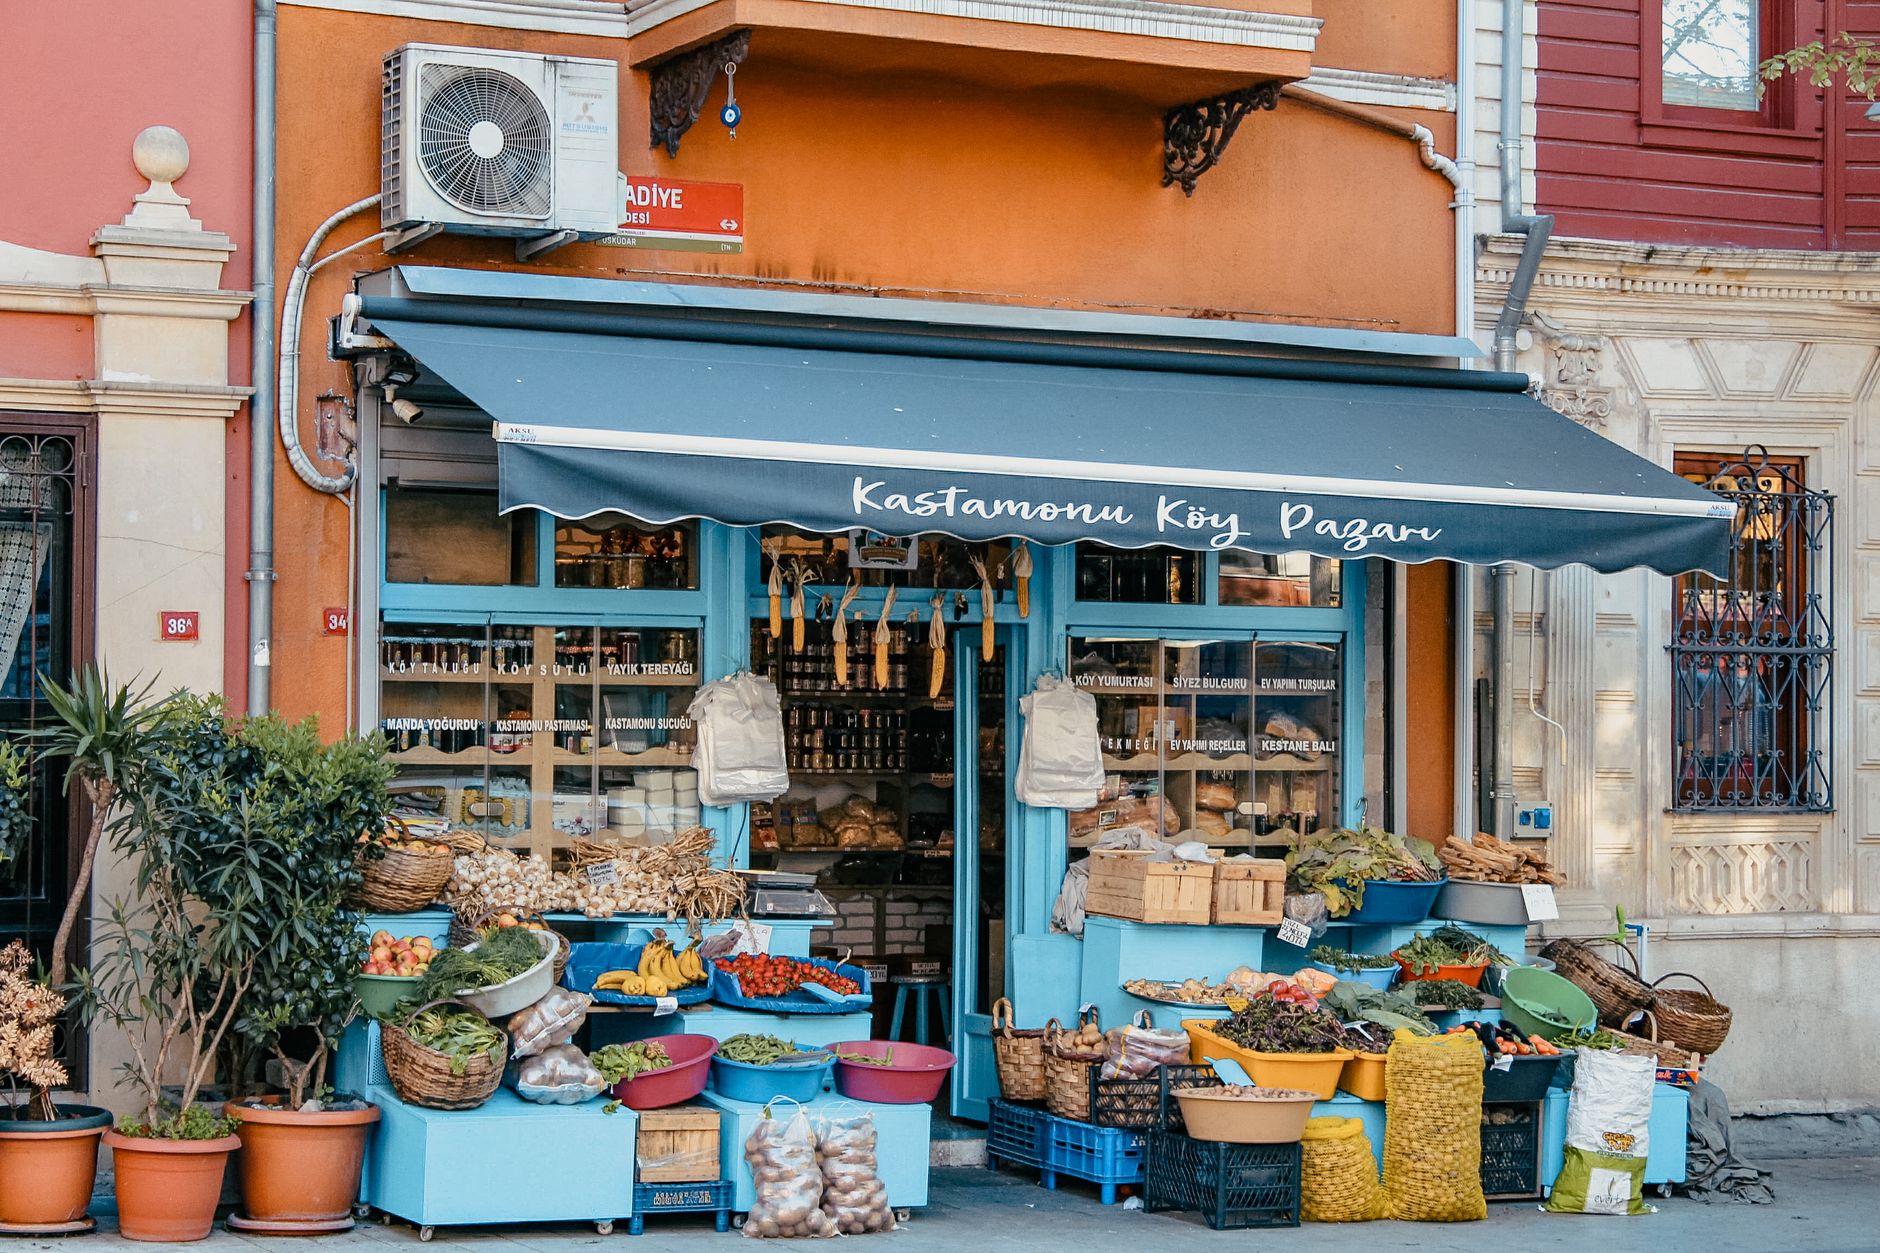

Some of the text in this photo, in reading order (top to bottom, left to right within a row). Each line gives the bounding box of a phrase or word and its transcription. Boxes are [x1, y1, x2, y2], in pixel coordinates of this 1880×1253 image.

[852, 476, 1442, 552] Kastamonu Köy Pazarı
[389, 660, 480, 674] KÖY TAVUĞU
[497, 662, 587, 677] KÖY SÜTÜ
[606, 661, 693, 676] YAYIK TEREYAĞI
[1075, 673, 1153, 688] KÖY YUMURTASI
[1173, 674, 1247, 689] SİYEZ BULGURU
[1261, 678, 1336, 692] EV YAPIMI TURŞULAR
[386, 716, 478, 731] MANDA YOĞURDU
[496, 719, 588, 732] KASTAMONU PASTIRMASI
[605, 715, 692, 730] KASTAMONU SUCUĞU
[1170, 739, 1246, 753] EV YAPIMI REÇELLER
[1262, 740, 1335, 752] KESTANE BALI
